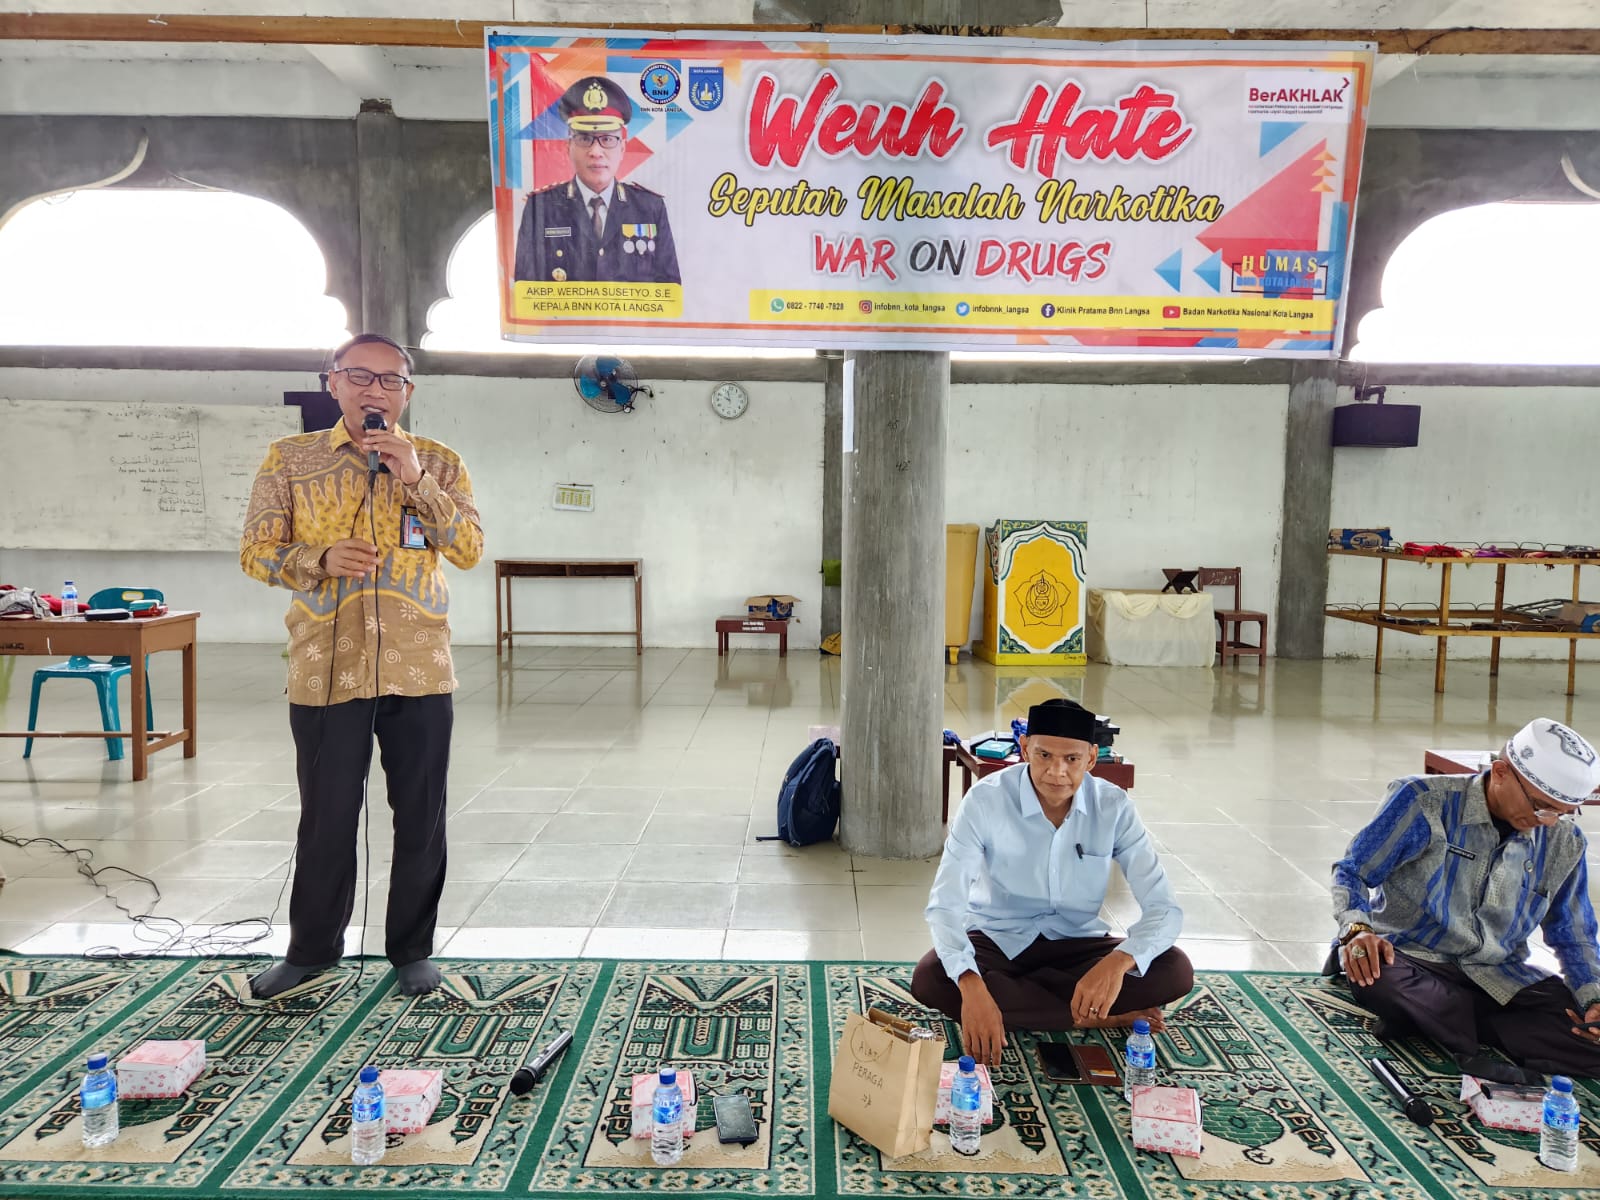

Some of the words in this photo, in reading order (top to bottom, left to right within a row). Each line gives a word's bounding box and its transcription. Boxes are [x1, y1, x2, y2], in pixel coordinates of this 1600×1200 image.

[1249, 87, 1344, 102] BerAKHLAK
[749, 73, 964, 168] Weuh
[987, 82, 1192, 177] Hate
[708, 172, 847, 226] Seputar
[858, 176, 1025, 222] Masalah
[1035, 178, 1223, 224] Narkotika
[815, 235, 896, 280] WAR
[909, 239, 966, 276] ON
[975, 240, 1110, 282] DRUGS
[1242, 255, 1318, 273] HUMAS
[557, 287, 600, 297] WERDHA
[533, 301, 570, 311] KEPALA
[572, 302, 592, 311] BNN
[595, 302, 621, 311] KOTA
[623, 303, 664, 312] LANGSA
[786, 302, 803, 310] 0822
[1057, 306, 1077, 315] Klinik
[1078, 306, 1107, 315] Pratama
[1109, 307, 1123, 315] Bnn
[1125, 307, 1150, 316] Langsa
[1183, 307, 1205, 316] Badan
[1207, 308, 1240, 316] Narkotika
[1242, 308, 1272, 317] Nasional
[1273, 309, 1288, 318] Kota
[1289, 310, 1314, 320] Langsa
[853, 1061, 883, 1088] PERAGA
